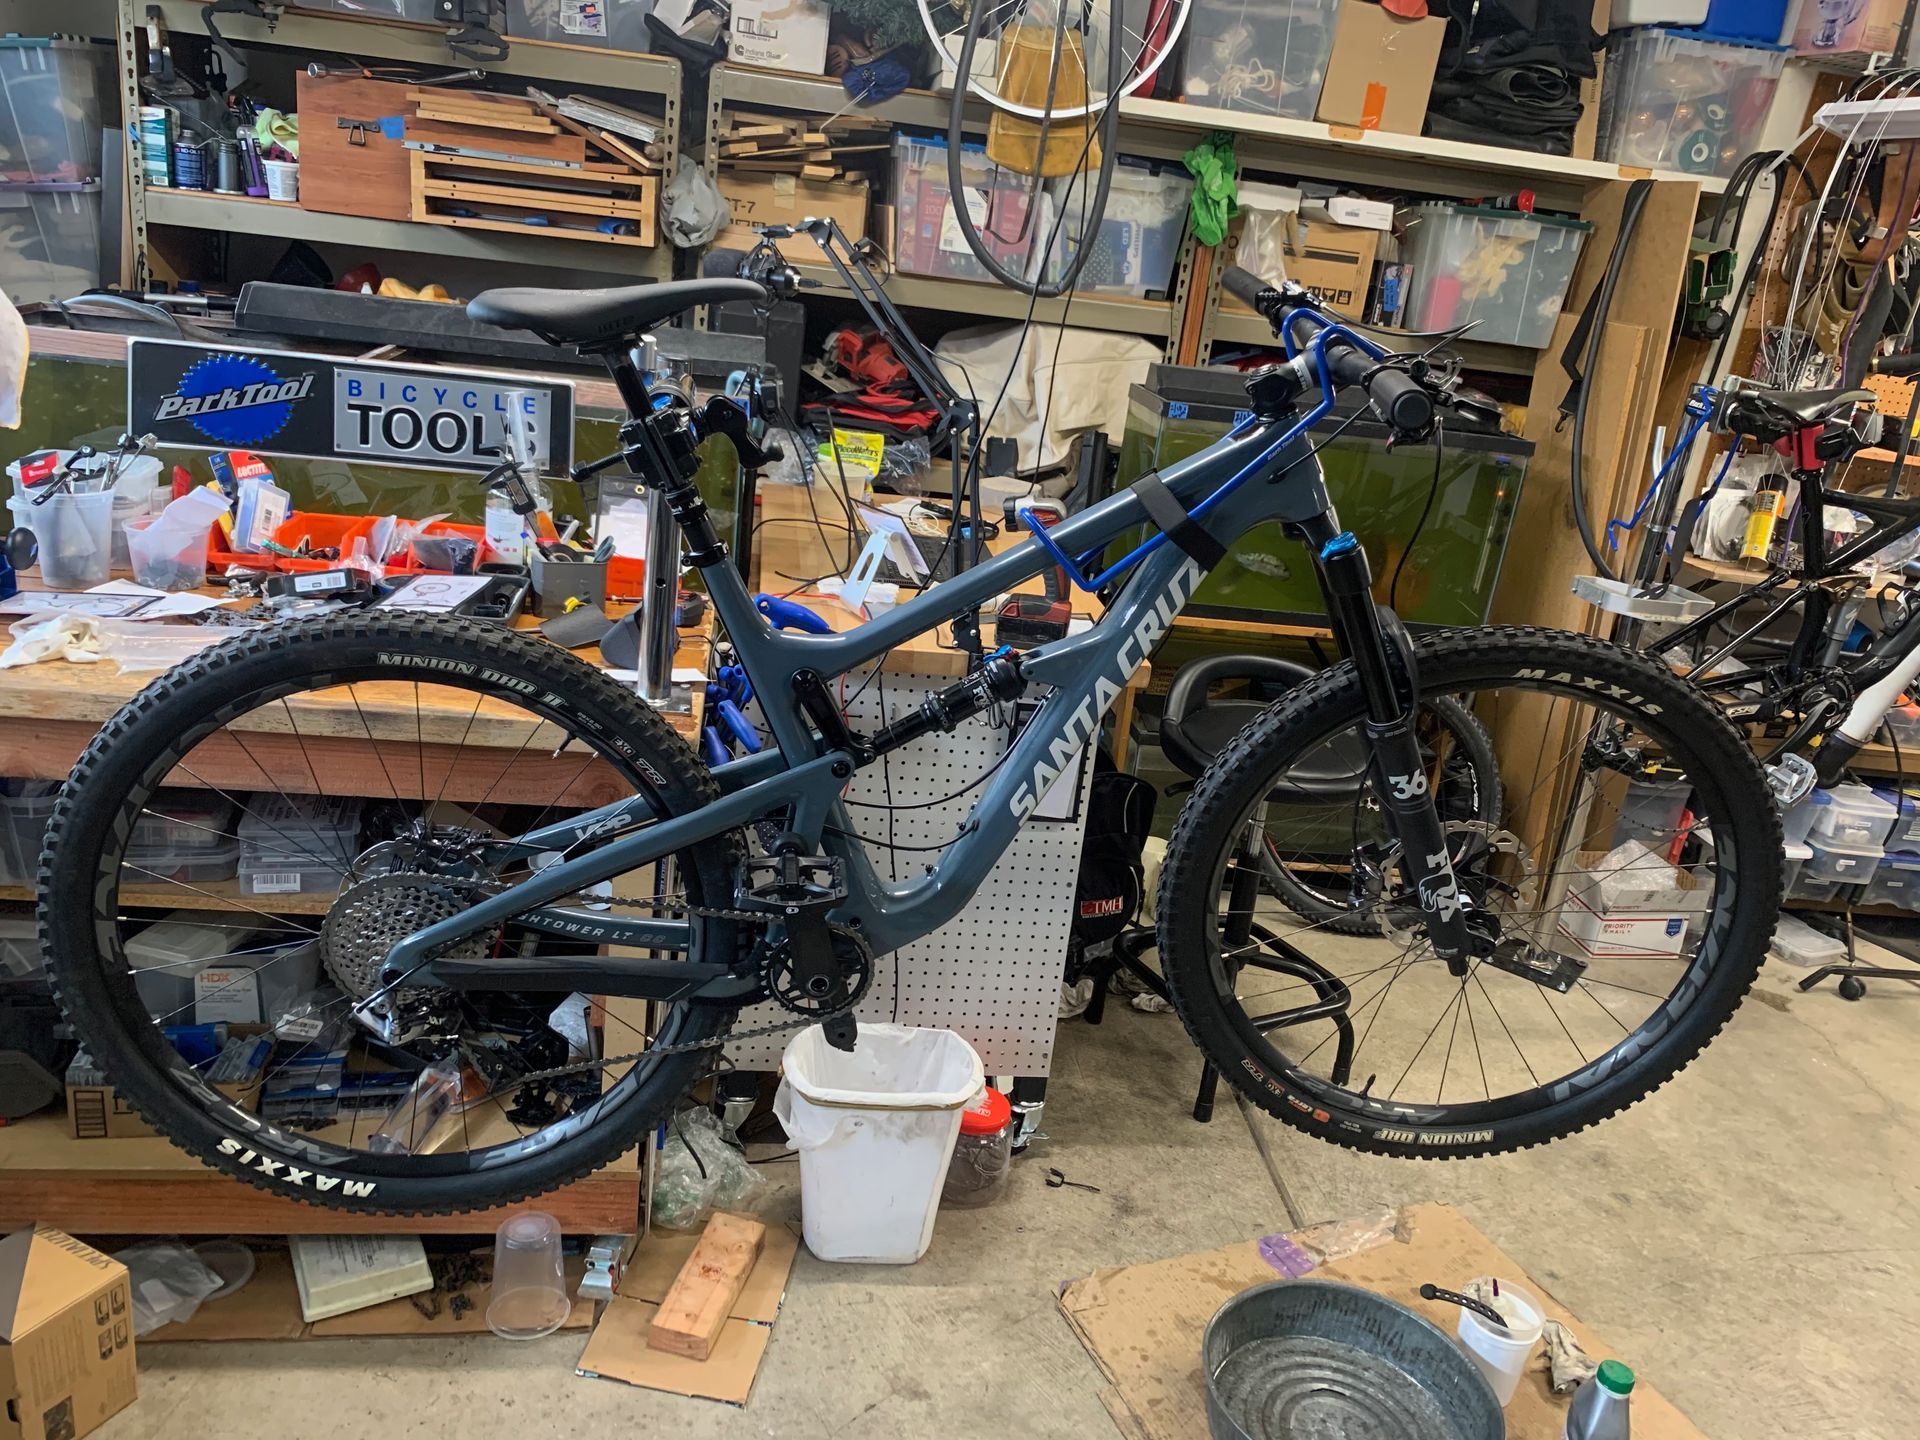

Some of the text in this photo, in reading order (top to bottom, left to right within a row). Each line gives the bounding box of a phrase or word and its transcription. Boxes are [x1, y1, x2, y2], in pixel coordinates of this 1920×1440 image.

[347, 379, 536, 415] BICYCLE
[347, 403, 537, 458] TOOL
[237, 463, 270, 479] LOCTITE
[377, 652, 478, 675] MINION
[479, 667, 539, 695] DHR
[1009, 555, 1209, 828] SANTA CRUZ
[1511, 668, 1664, 716] MAXXIS
[636, 758, 667, 785] TR
[1388, 768, 1427, 800] 36
[1094, 896, 1122, 914] TMH
[611, 931, 633, 940] LT
[1603, 922, 1636, 930] PRIORITY
[199, 972, 232, 983] HDX
[1372, 1127, 1495, 1146] MINION DHF
[215, 1137, 378, 1199] MAXXIS
